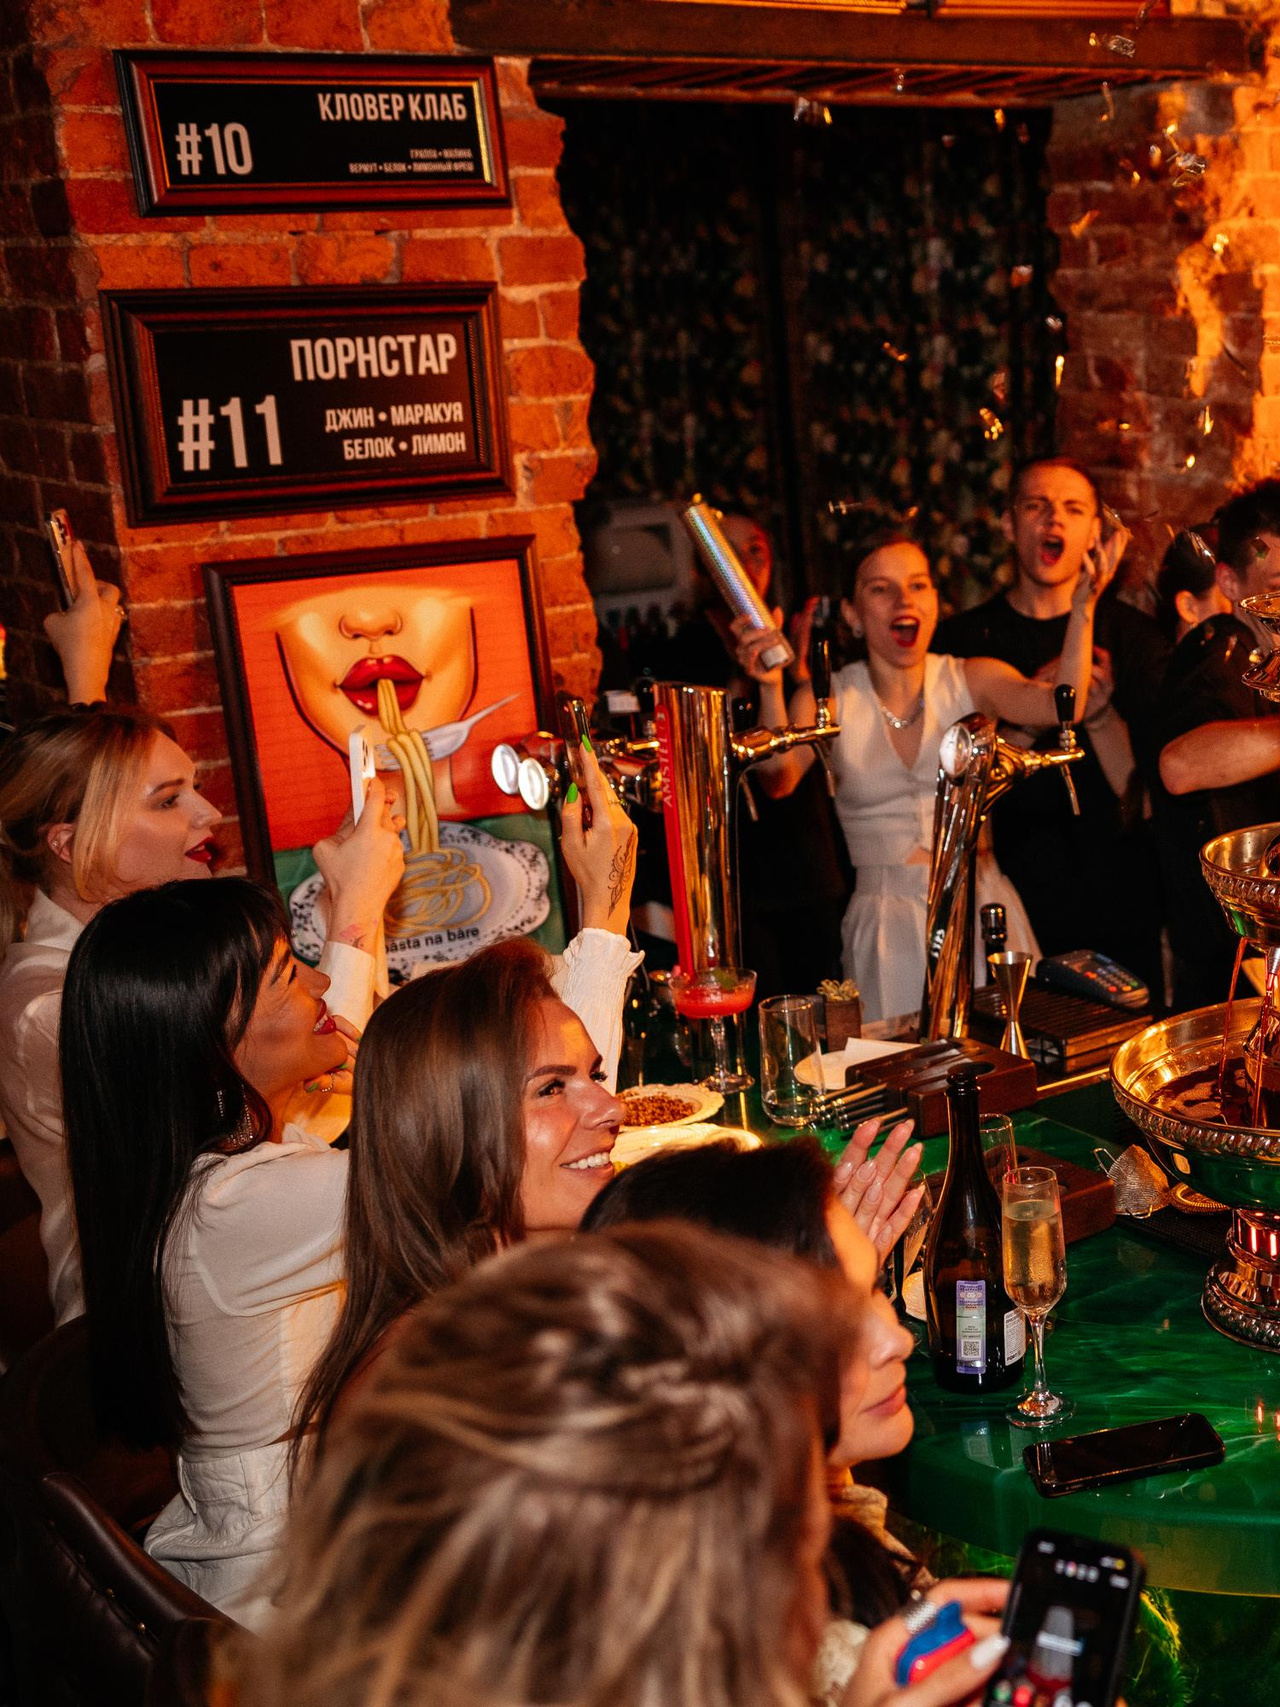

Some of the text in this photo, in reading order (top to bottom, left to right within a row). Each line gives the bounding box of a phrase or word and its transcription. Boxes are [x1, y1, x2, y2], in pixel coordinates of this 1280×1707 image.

[318, 93, 467, 121] КЛОВЕР КЛАБ
[175, 122, 254, 176] #10
[290, 333, 458, 382] ПОРНСТАР
[177, 395, 283, 472] #11
[325, 401, 464, 433] ДЖИН МАРАКУЯ
[343, 432, 466, 461] БЕЛОК ЛИМОН
[659, 736, 673, 808] AMSTEL
[424, 933, 442, 947] na
